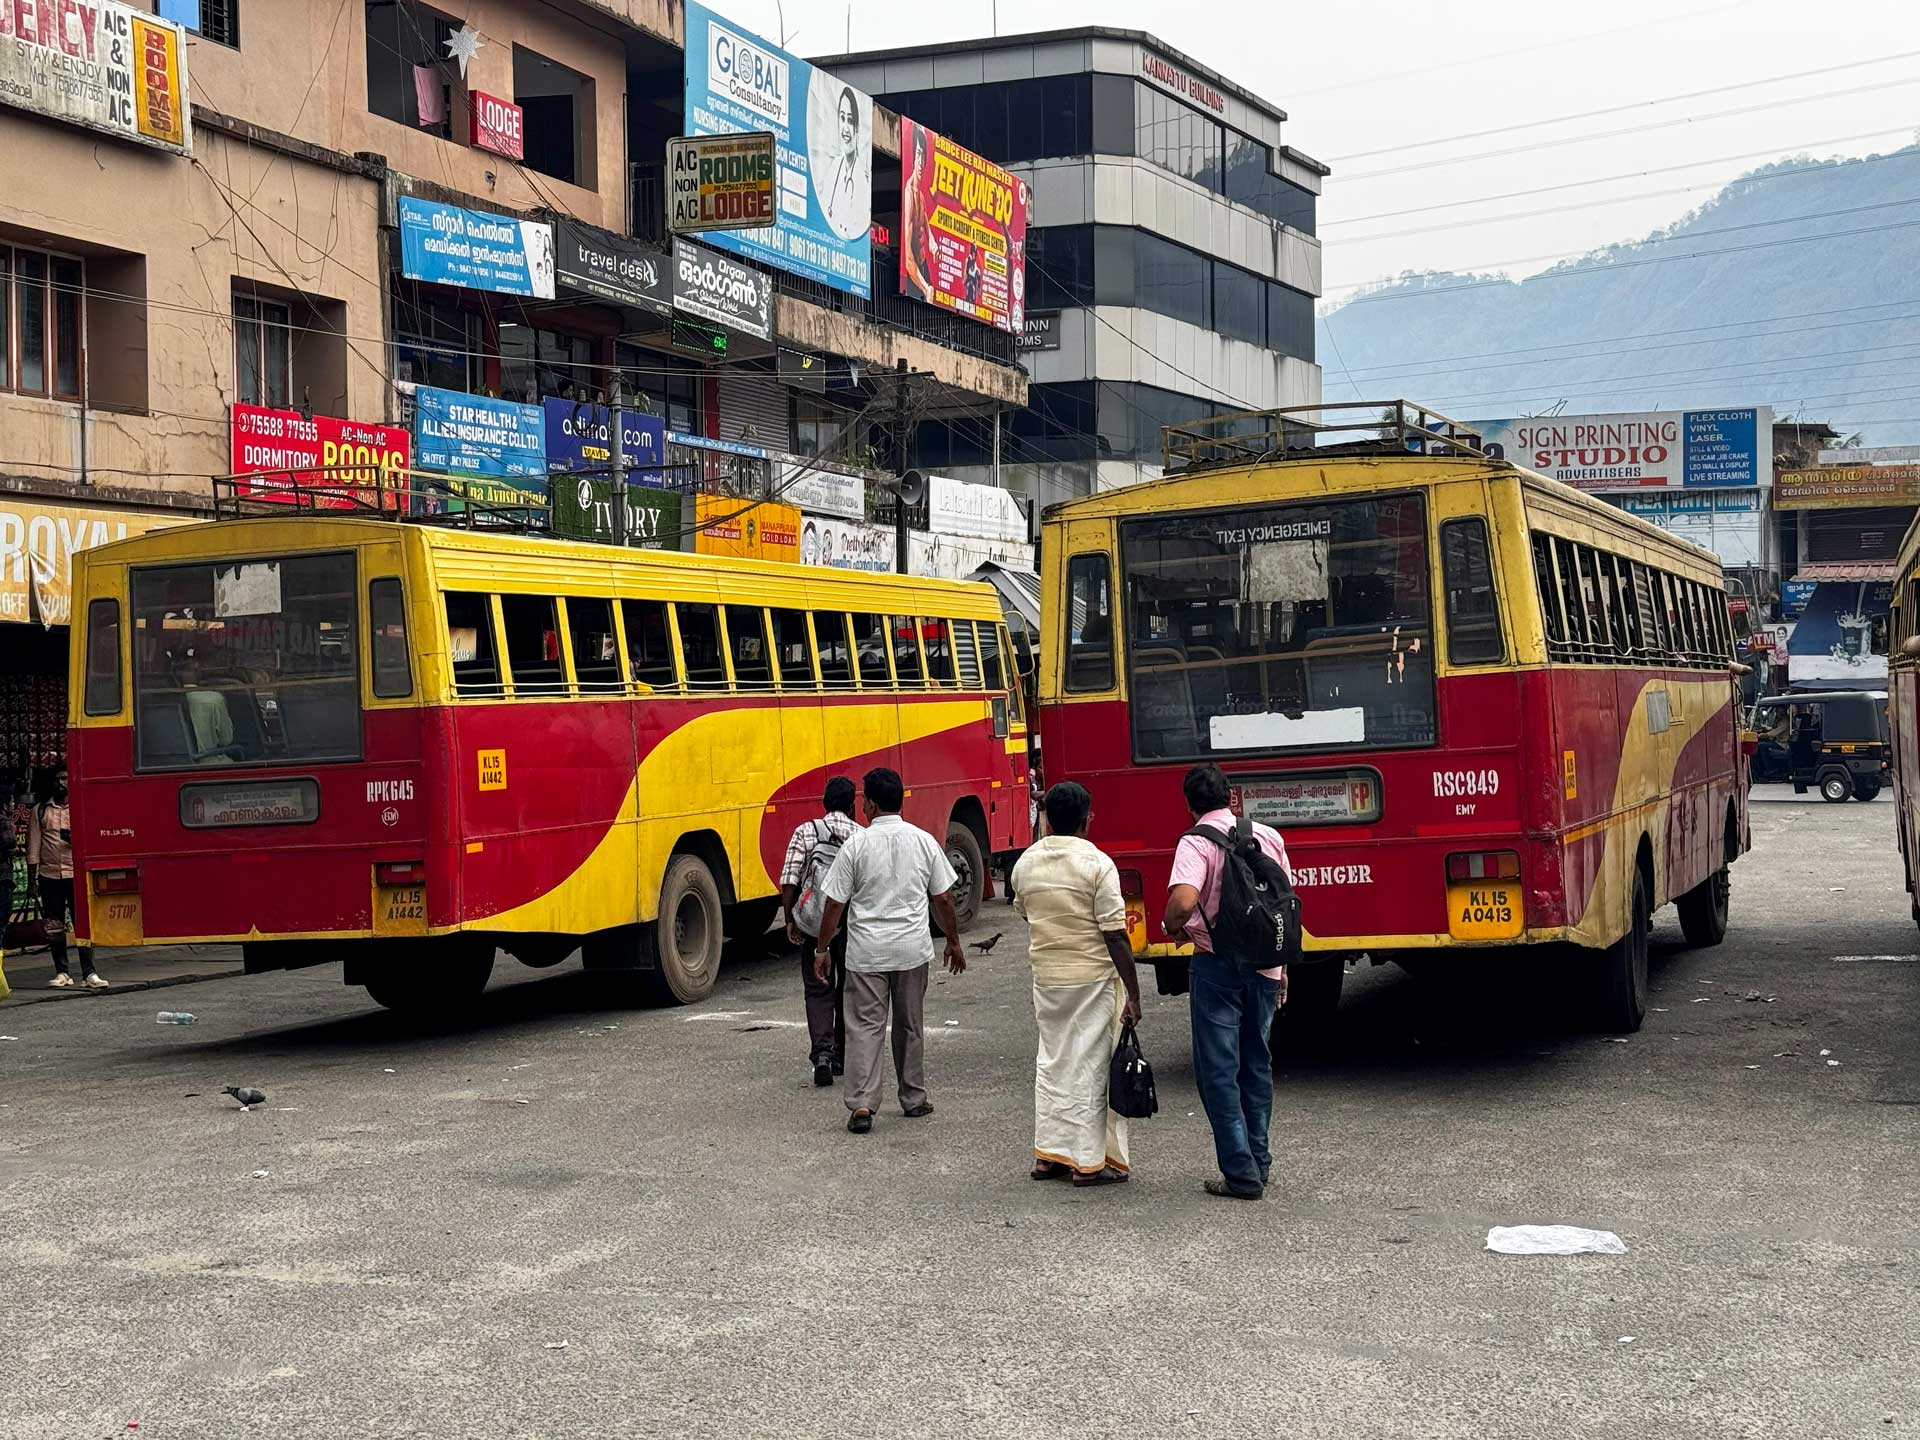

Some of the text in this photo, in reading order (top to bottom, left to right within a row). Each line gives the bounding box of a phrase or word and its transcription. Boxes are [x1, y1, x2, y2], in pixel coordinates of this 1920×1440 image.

[105, 10, 127, 36] A/C
[17, 41, 101, 80] STAY & ENJOY
[111, 39, 125, 66] &
[144, 28, 172, 132] ROOMS
[716, 36, 782, 100] GLOBAL
[107, 67, 130, 95] NON
[109, 94, 132, 125] A/C
[730, 79, 782, 119] Consultancy
[479, 97, 520, 139] LODGE
[693, 106, 718, 132] NURSING
[675, 145, 697, 175] A/C
[700, 154, 772, 185] ROOMS
[934, 134, 960, 160] BRUCE
[961, 148, 973, 165] LEE
[986, 162, 1013, 186] MASTER
[675, 178, 697, 192] NON
[930, 152, 1013, 226] JEET KUNE DO
[676, 196, 698, 224] A/C
[701, 191, 771, 221] LODGE
[579, 244, 651, 284] travel desk
[718, 259, 747, 281] Organ
[1025, 319, 1049, 331] INN
[1015, 334, 1042, 346] OMS
[250, 414, 318, 442] 75588 77555
[450, 405, 473, 424] STAR
[475, 409, 511, 430] HEALTH
[512, 416, 518, 430] &
[1690, 411, 1752, 422] FLEX CLOTH
[1690, 424, 1719, 432] VINYL
[375, 431, 387, 446] AC
[422, 420, 457, 438] ALLIED
[458, 425, 507, 445] INSURANCE
[1518, 421, 1677, 449] SIGN PRINTING
[245, 445, 318, 470] DORMITORY
[323, 440, 404, 488] ROOMS
[1535, 445, 1667, 468] STUDIO
[1725, 461, 1750, 469] DISPLAY
[1557, 466, 1641, 480] ADVERTISERS
[1690, 471, 1750, 481] LIVE STREAMING
[0, 512, 127, 585] ROY
[762, 534, 779, 545] GOLD
[482, 771, 502, 784] A1442
[1433, 769, 1499, 797] RSC849
[367, 780, 414, 802] RPK645
[1351, 783, 1370, 810] FP
[1456, 804, 1476, 815] EMY
[1290, 864, 1374, 887] SSENGER
[392, 891, 420, 904] KL 15
[1470, 891, 1507, 906] KL 15
[109, 904, 136, 920] STOP
[387, 906, 423, 920] A1442
[1462, 907, 1512, 923] A0413
[1276, 913, 1285, 951] adidas
